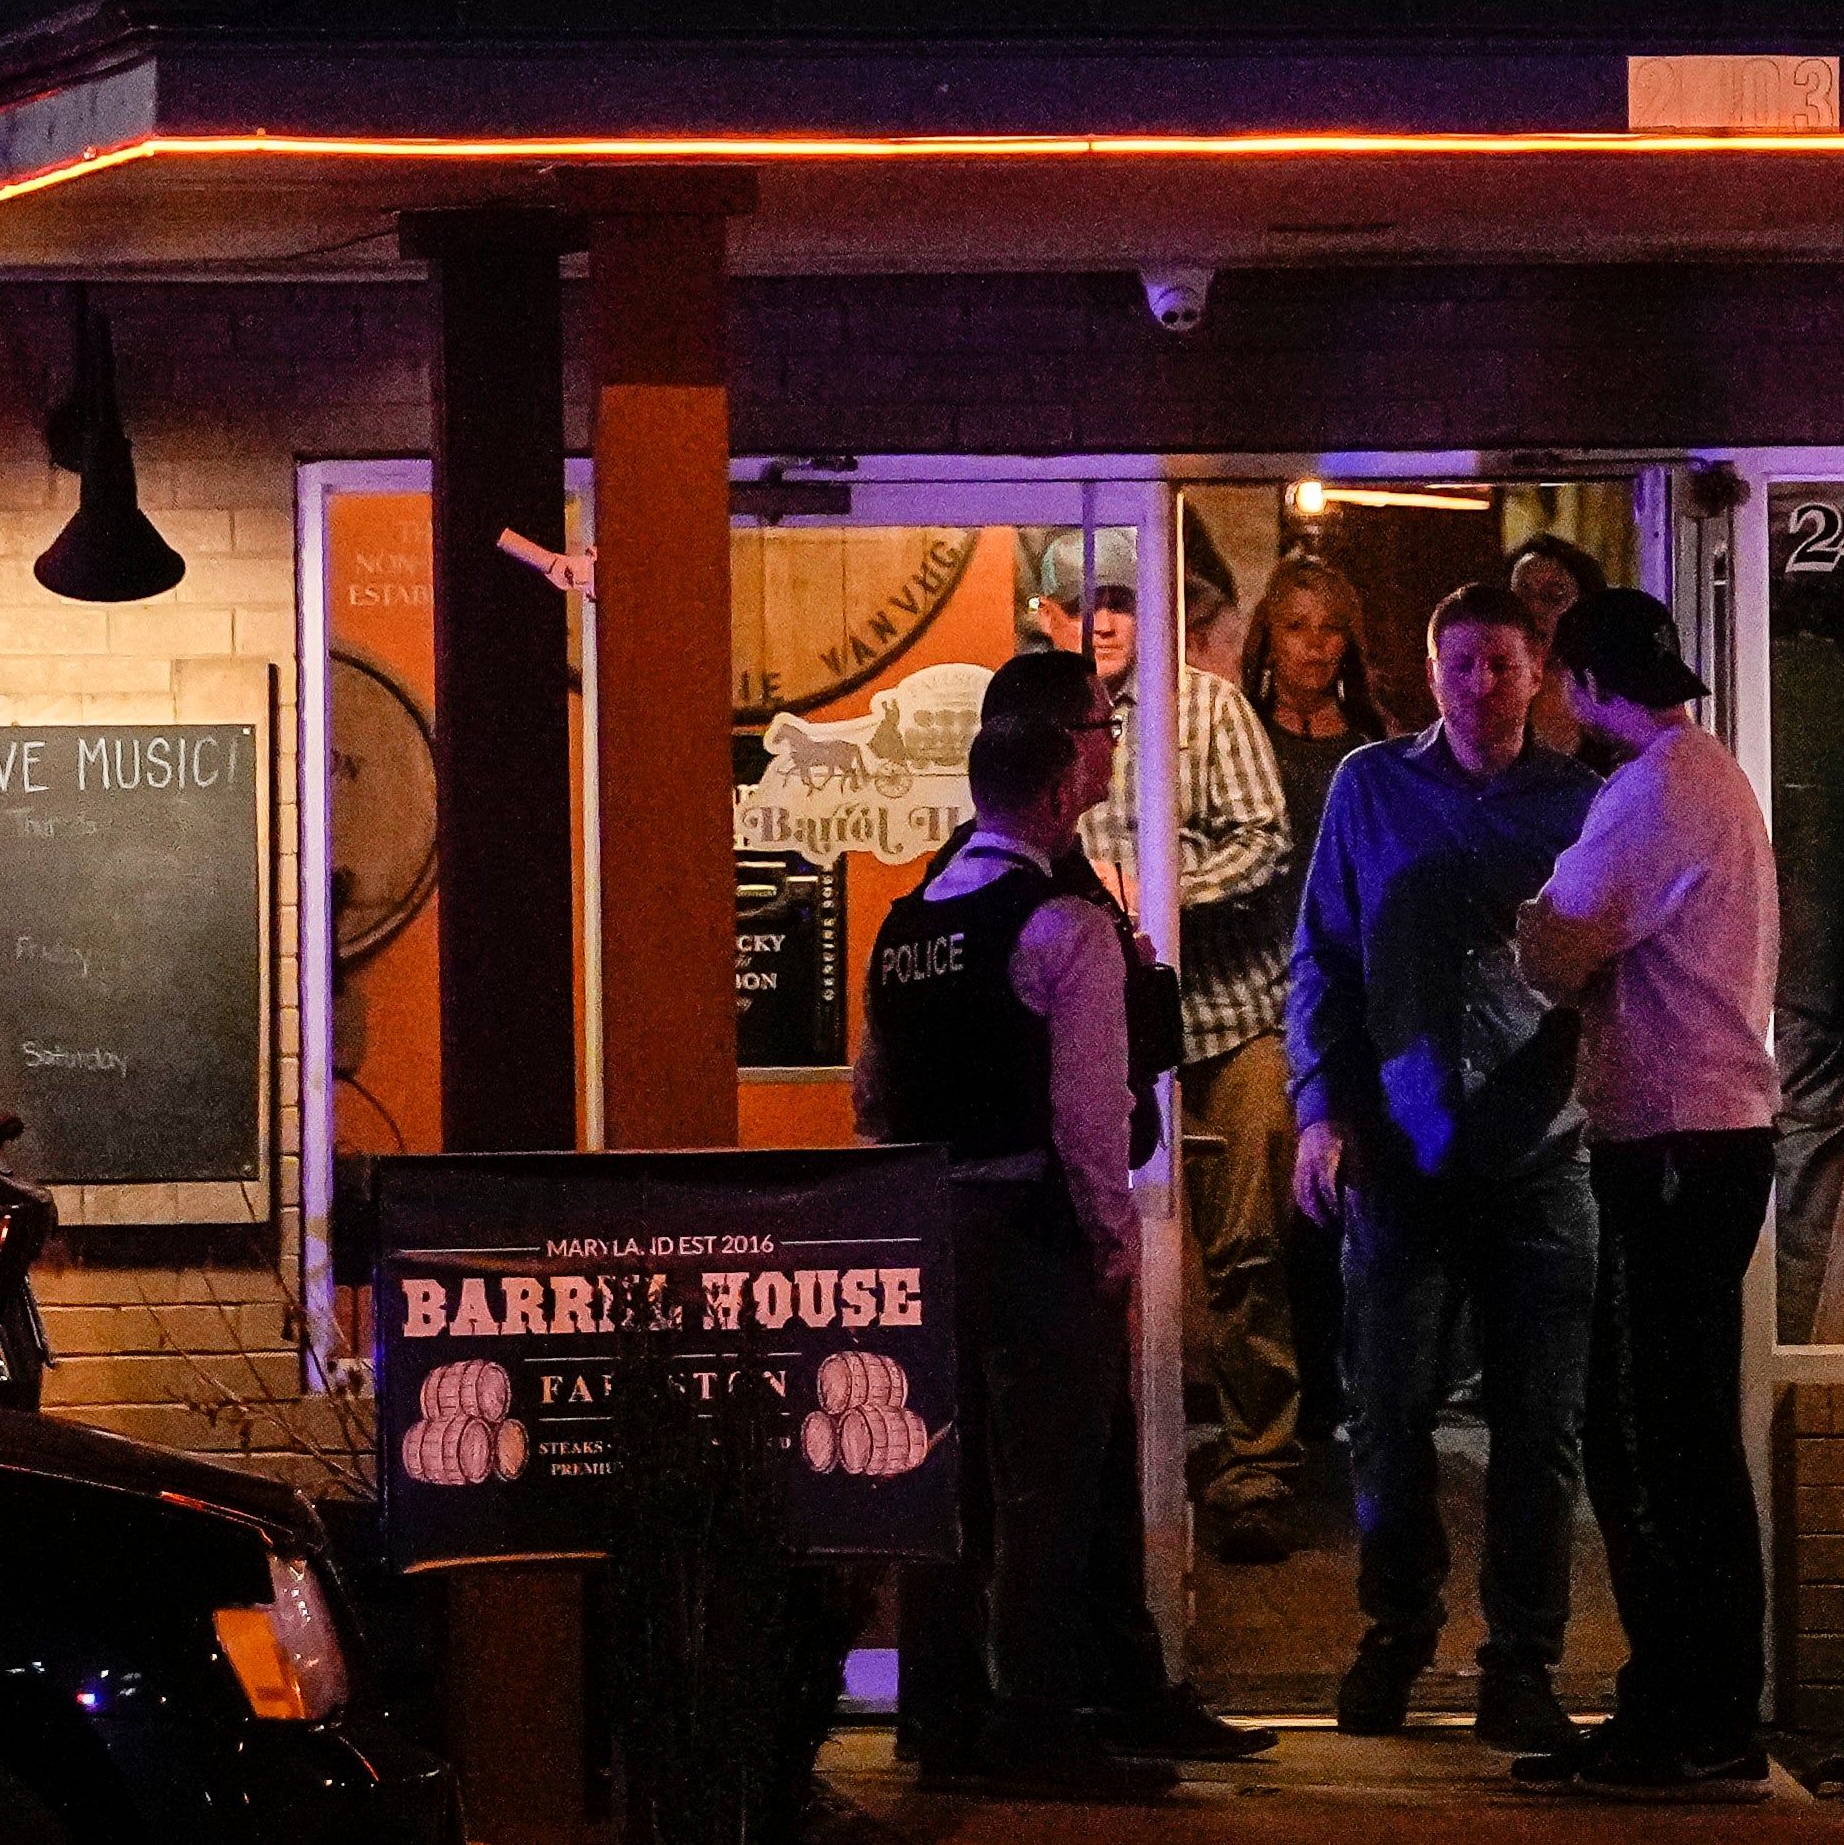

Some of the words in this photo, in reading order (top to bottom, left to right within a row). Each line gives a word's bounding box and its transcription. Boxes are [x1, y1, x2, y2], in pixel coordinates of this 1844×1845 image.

[76, 736, 239, 792] MUSIC!
[881, 932, 966, 987] POLICE
[679, 1235, 718, 1255] EST
[721, 1233, 775, 1255] 2016
[701, 1267, 923, 1331] HOUSE
[539, 1370, 787, 1404] FASTN
[551, 1460, 623, 1475] PREMIU
